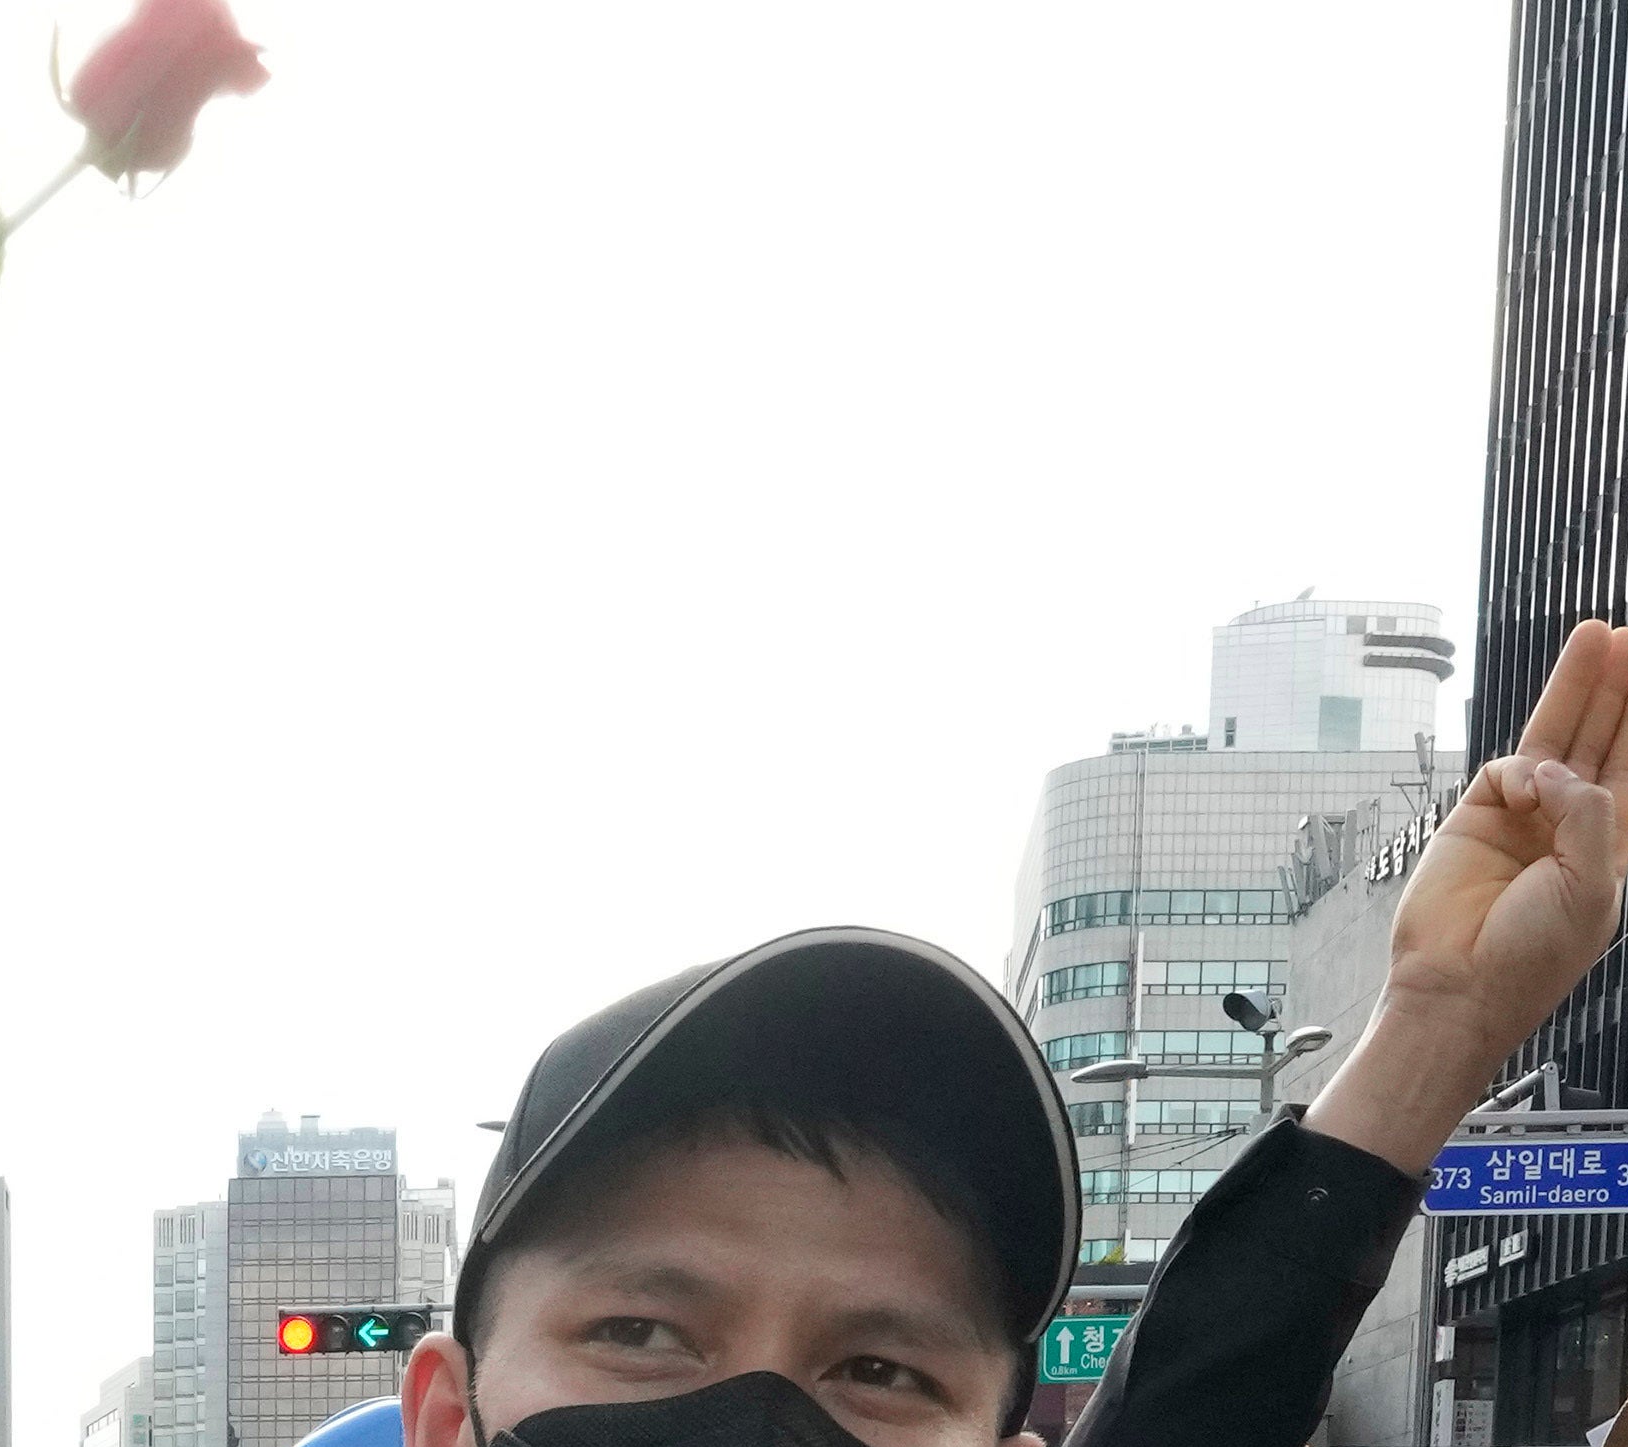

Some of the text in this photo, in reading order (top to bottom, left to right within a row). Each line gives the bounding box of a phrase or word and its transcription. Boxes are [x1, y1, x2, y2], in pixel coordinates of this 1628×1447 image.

[1430, 1167, 1472, 1190] 373
[1486, 1147, 1607, 1181] 삼일대로
[1479, 1184, 1610, 1206] Samil-daero
[1081, 1353, 1106, 1369] Che
